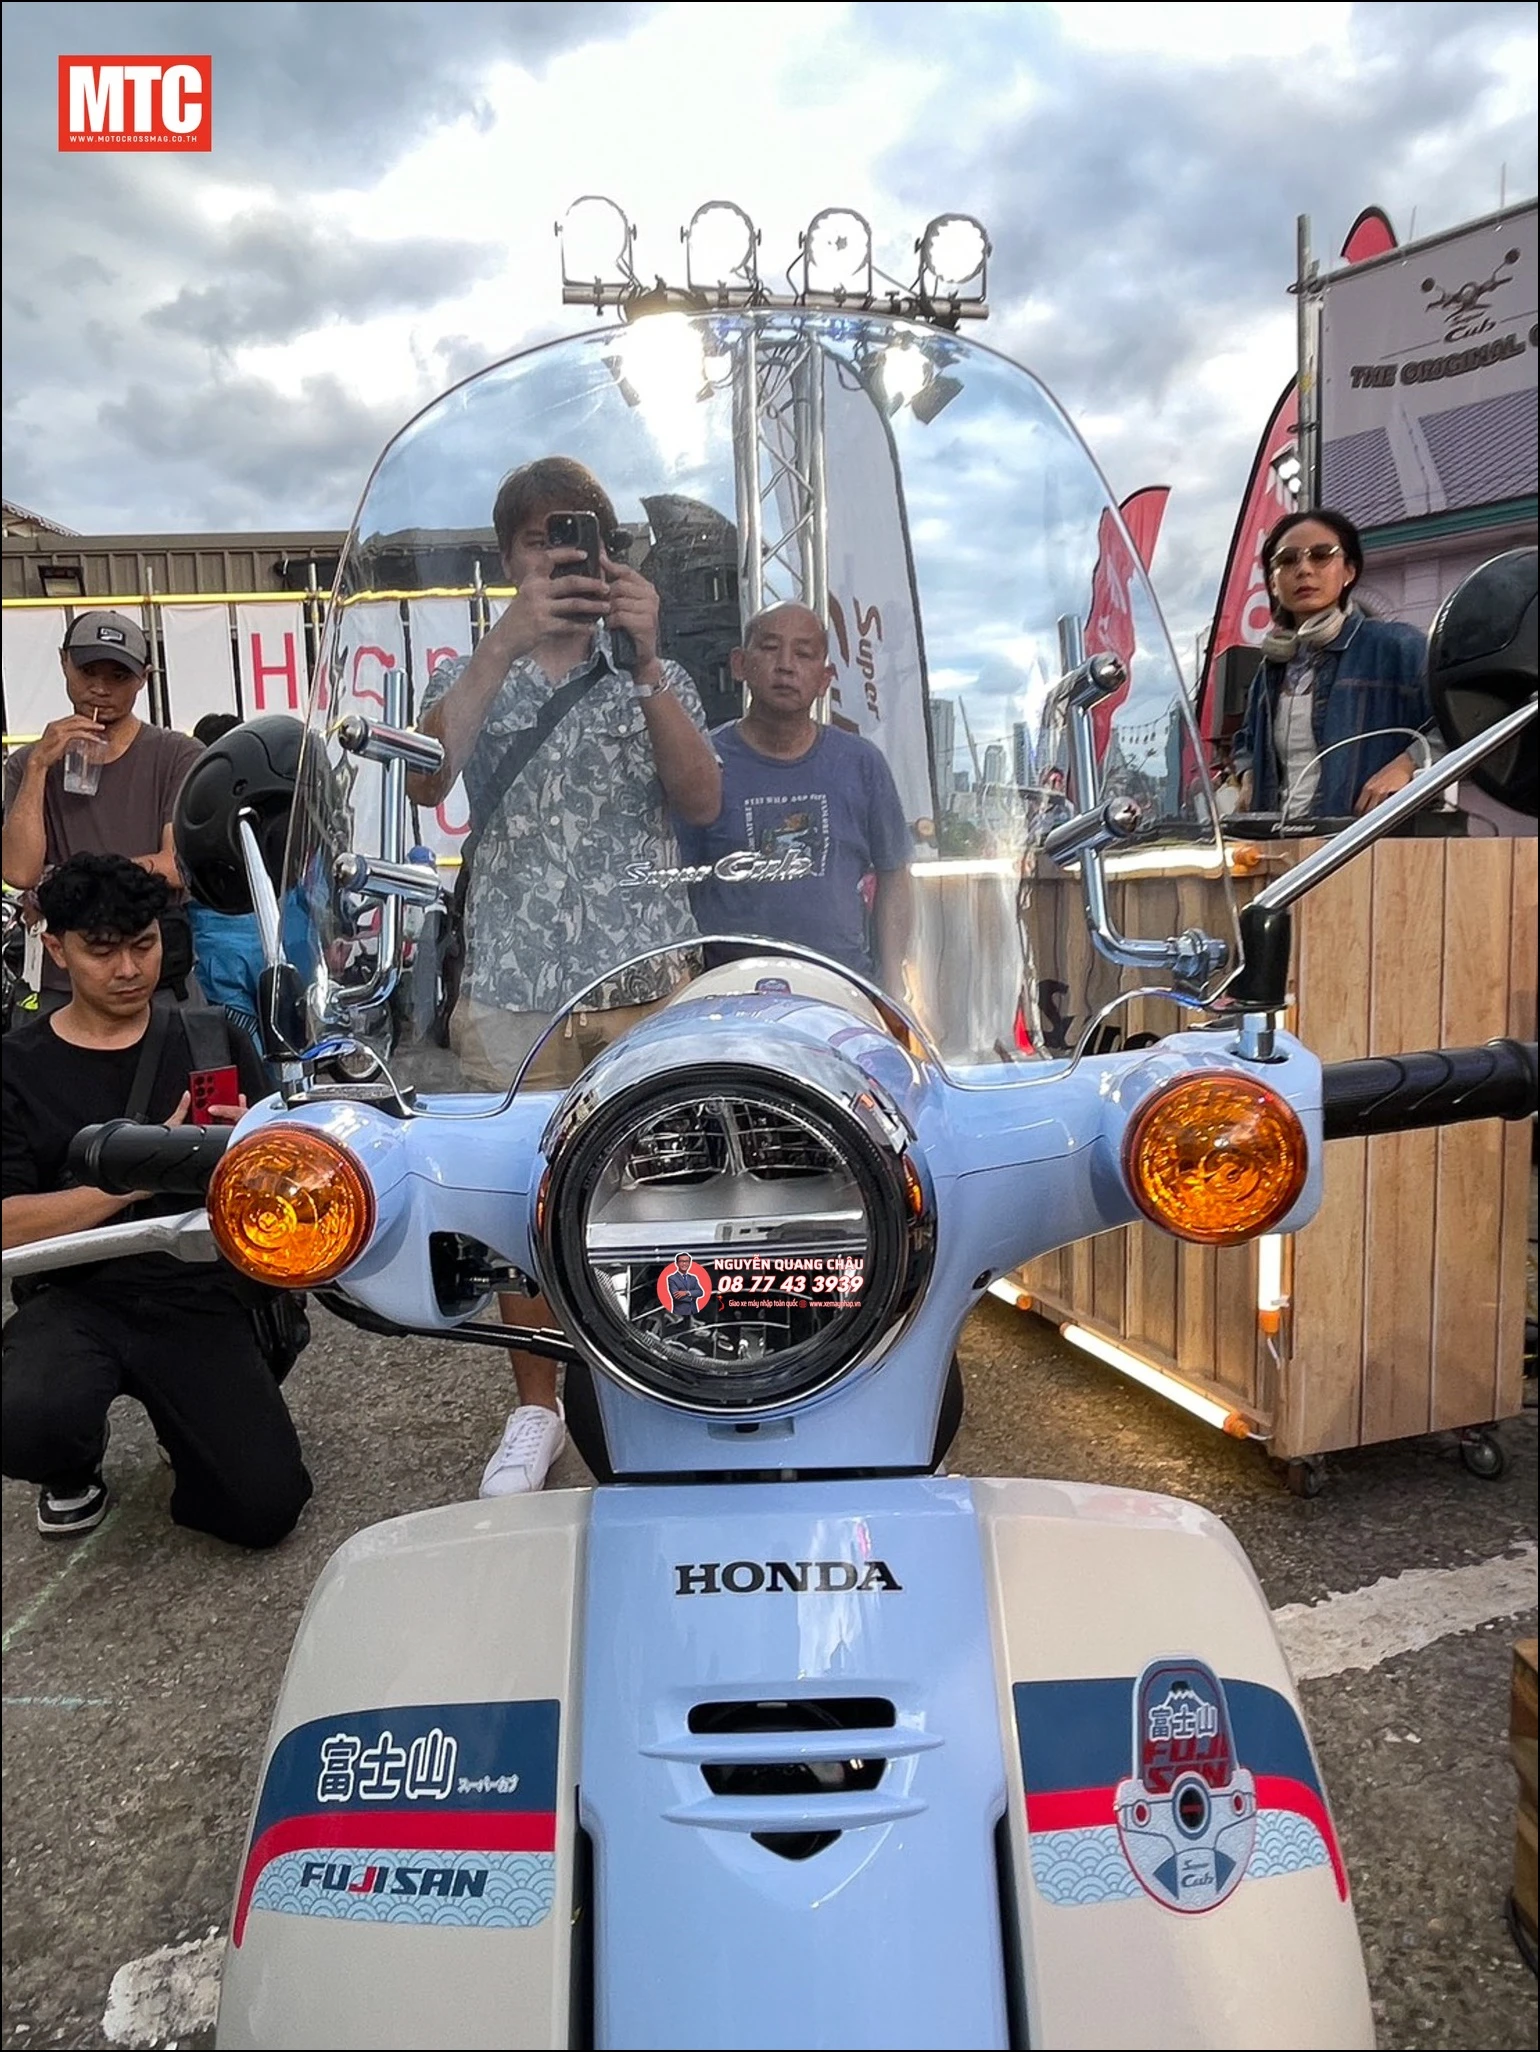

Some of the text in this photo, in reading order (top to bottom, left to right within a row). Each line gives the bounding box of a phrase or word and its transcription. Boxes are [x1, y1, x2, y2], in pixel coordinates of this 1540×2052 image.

[1443, 317, 1497, 343] Cub
[1350, 364, 1399, 389] THE
[1400, 333, 1527, 386] ORIGINAL
[852, 596, 882, 722] Super
[619, 849, 812, 890] Super Cub
[675, 1561, 903, 1595] HONDA
[1148, 1702, 1218, 1742] 富士山
[317, 1728, 457, 1802] 富士山
[1143, 1735, 1230, 1766] FUJI
[300, 1862, 489, 1898] FUJISAN
[1181, 1871, 1214, 1888] Cub
